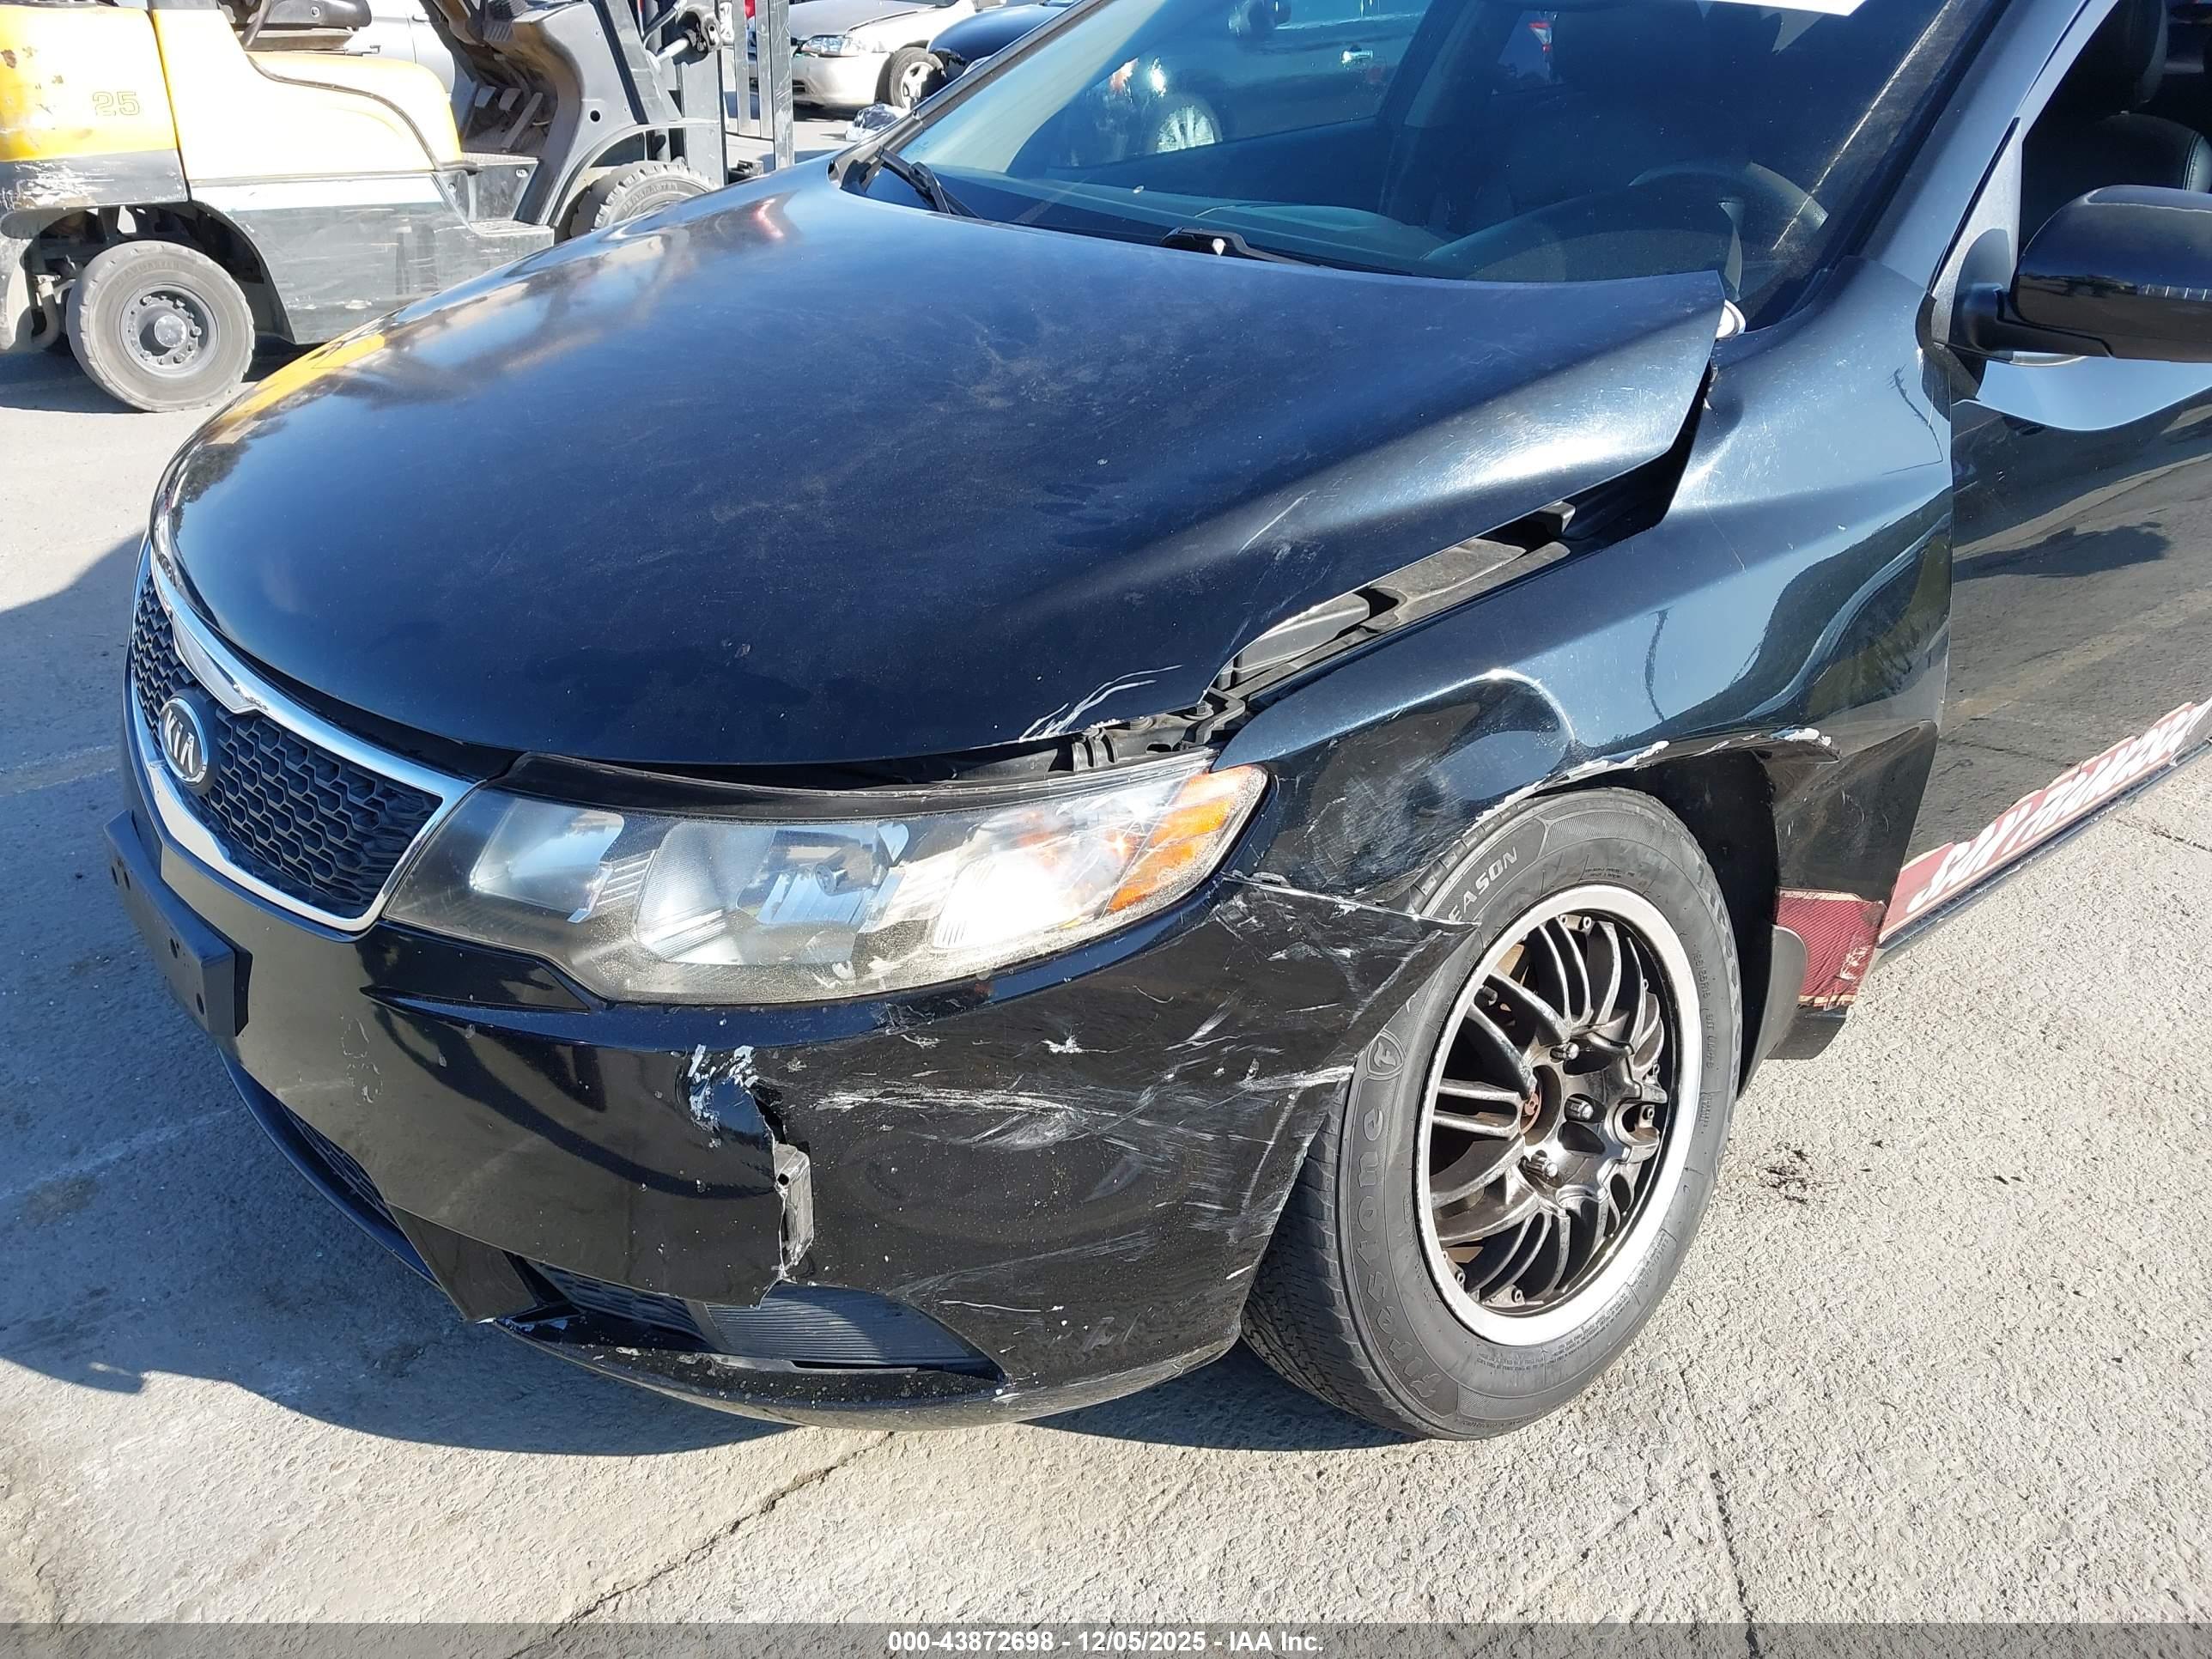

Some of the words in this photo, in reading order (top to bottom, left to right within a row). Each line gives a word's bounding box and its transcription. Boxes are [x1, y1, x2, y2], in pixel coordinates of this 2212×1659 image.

[92, 91, 140, 116] 25
[1905, 800, 2033, 914] SAN
[1357, 1107, 1443, 1399] Firestone
